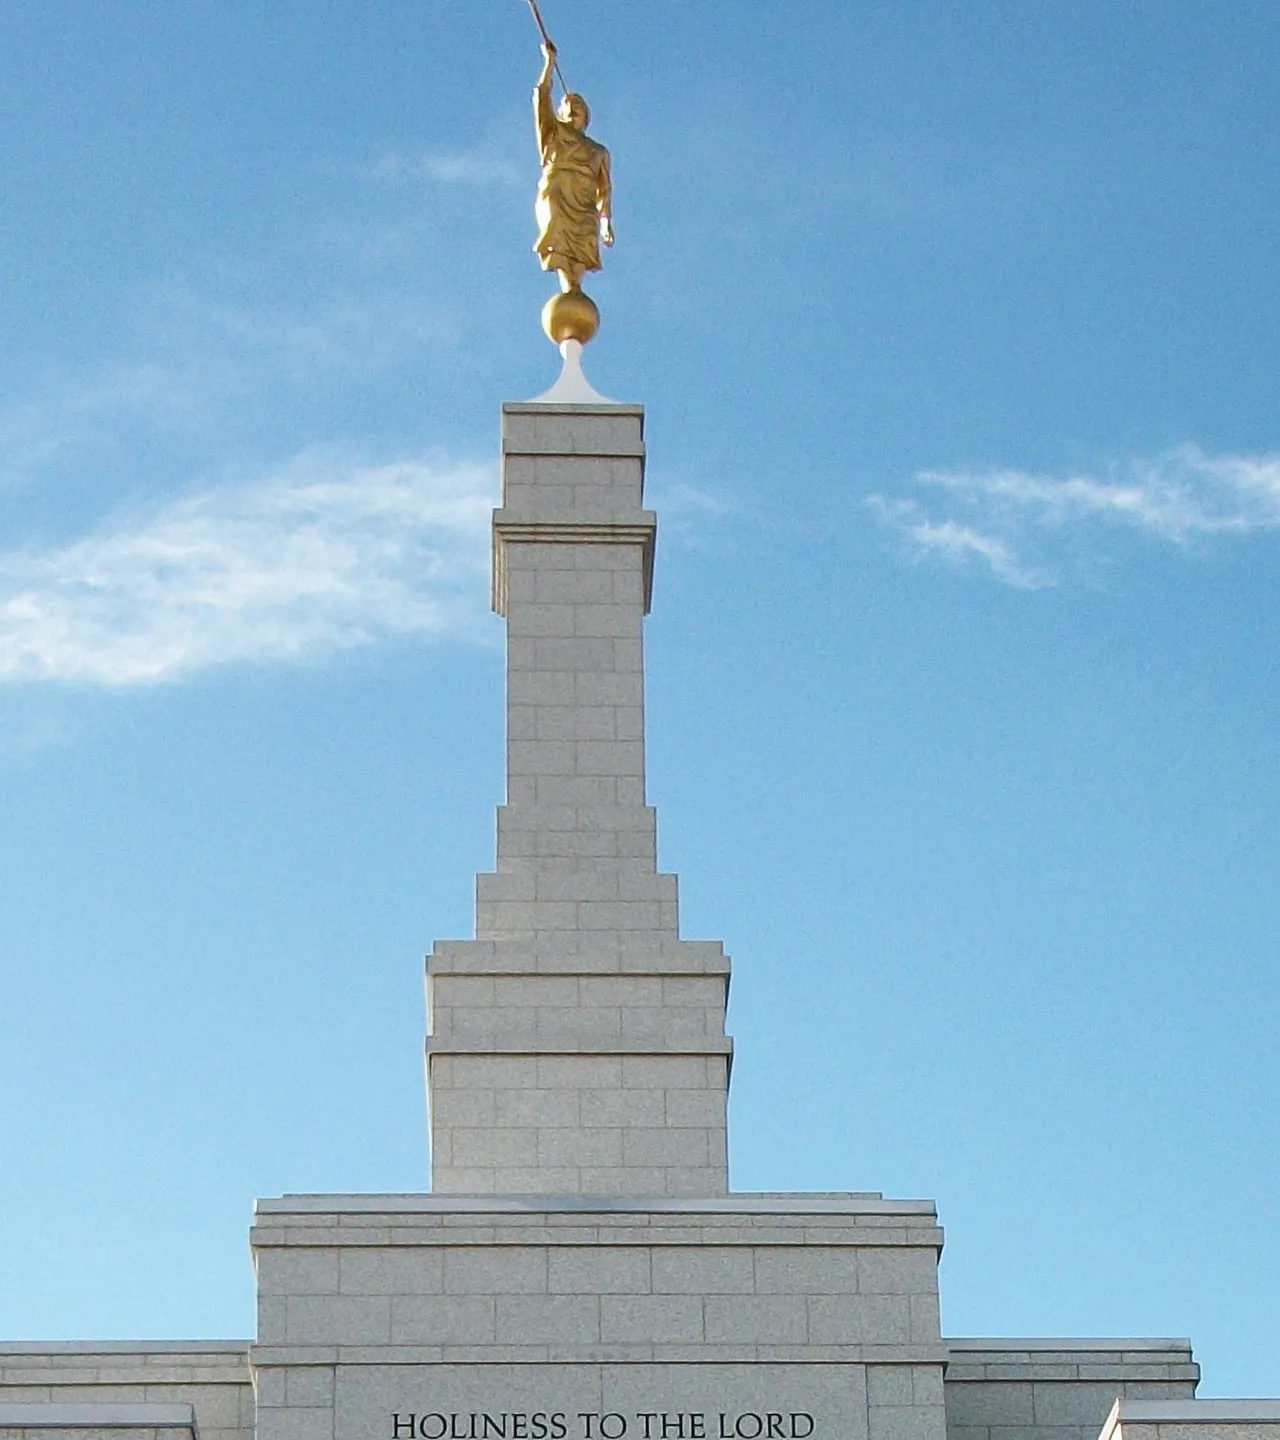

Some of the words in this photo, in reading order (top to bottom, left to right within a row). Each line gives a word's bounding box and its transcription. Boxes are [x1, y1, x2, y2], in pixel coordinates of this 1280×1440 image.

[390, 1412, 567, 1440] HOLINESS
[577, 1412, 627, 1440] TO
[636, 1412, 706, 1440] THE
[718, 1412, 816, 1440] LORD
